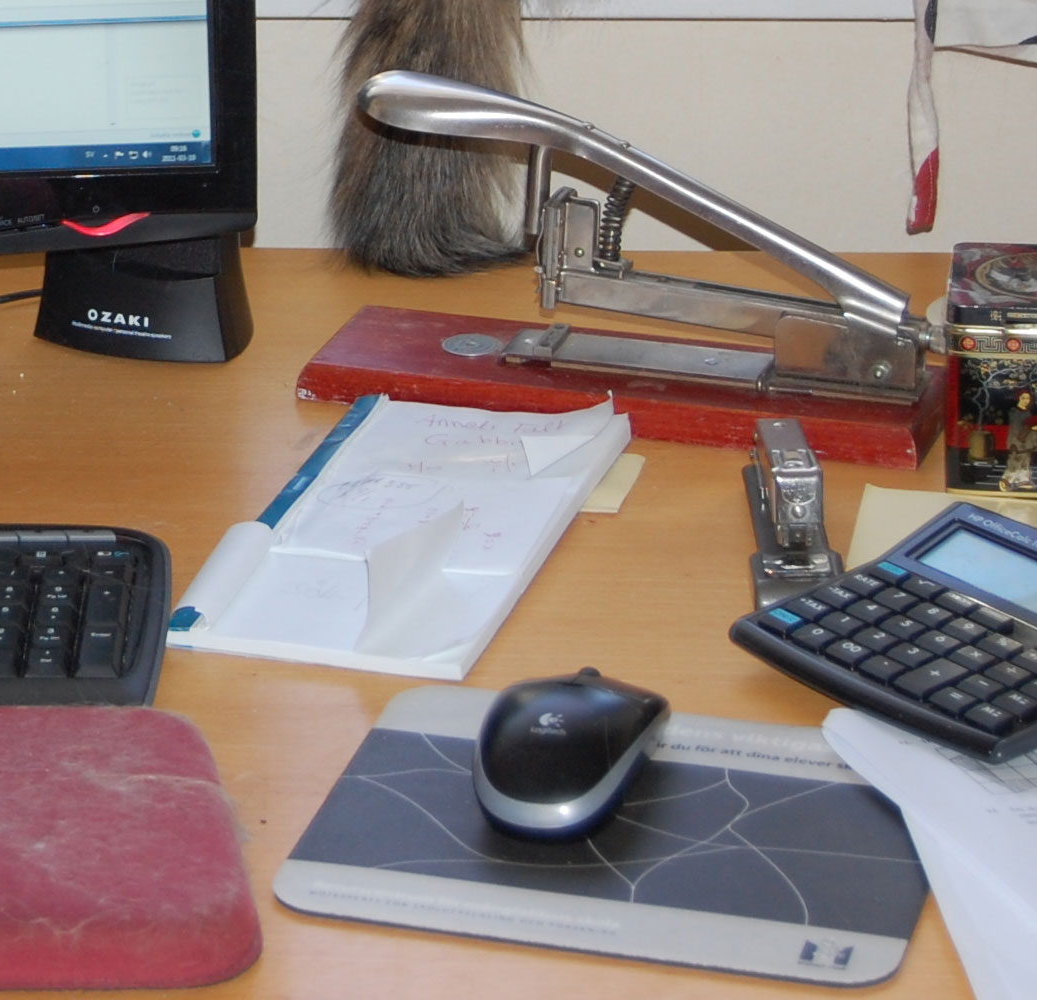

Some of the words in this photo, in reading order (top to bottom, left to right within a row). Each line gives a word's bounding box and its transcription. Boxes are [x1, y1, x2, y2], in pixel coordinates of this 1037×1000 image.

[87, 308, 150, 328] OZAKI
[967, 513, 985, 526] HP
[854, 573, 880, 588] RATE
[893, 591, 907, 599] 7
[866, 603, 878, 612] 4
[927, 606, 940, 616] 8
[840, 615, 851, 623] 1
[900, 619, 914, 628] 5
[963, 622, 975, 631] 9
[812, 627, 824, 636] 0
[872, 632, 886, 640] 2
[934, 635, 947, 643] 6
[842, 641, 862, 653] 00
[907, 647, 920, 655] 3
[720, 748, 743, 757] att
[746, 750, 781, 762] dina
[784, 755, 832, 769] elever
